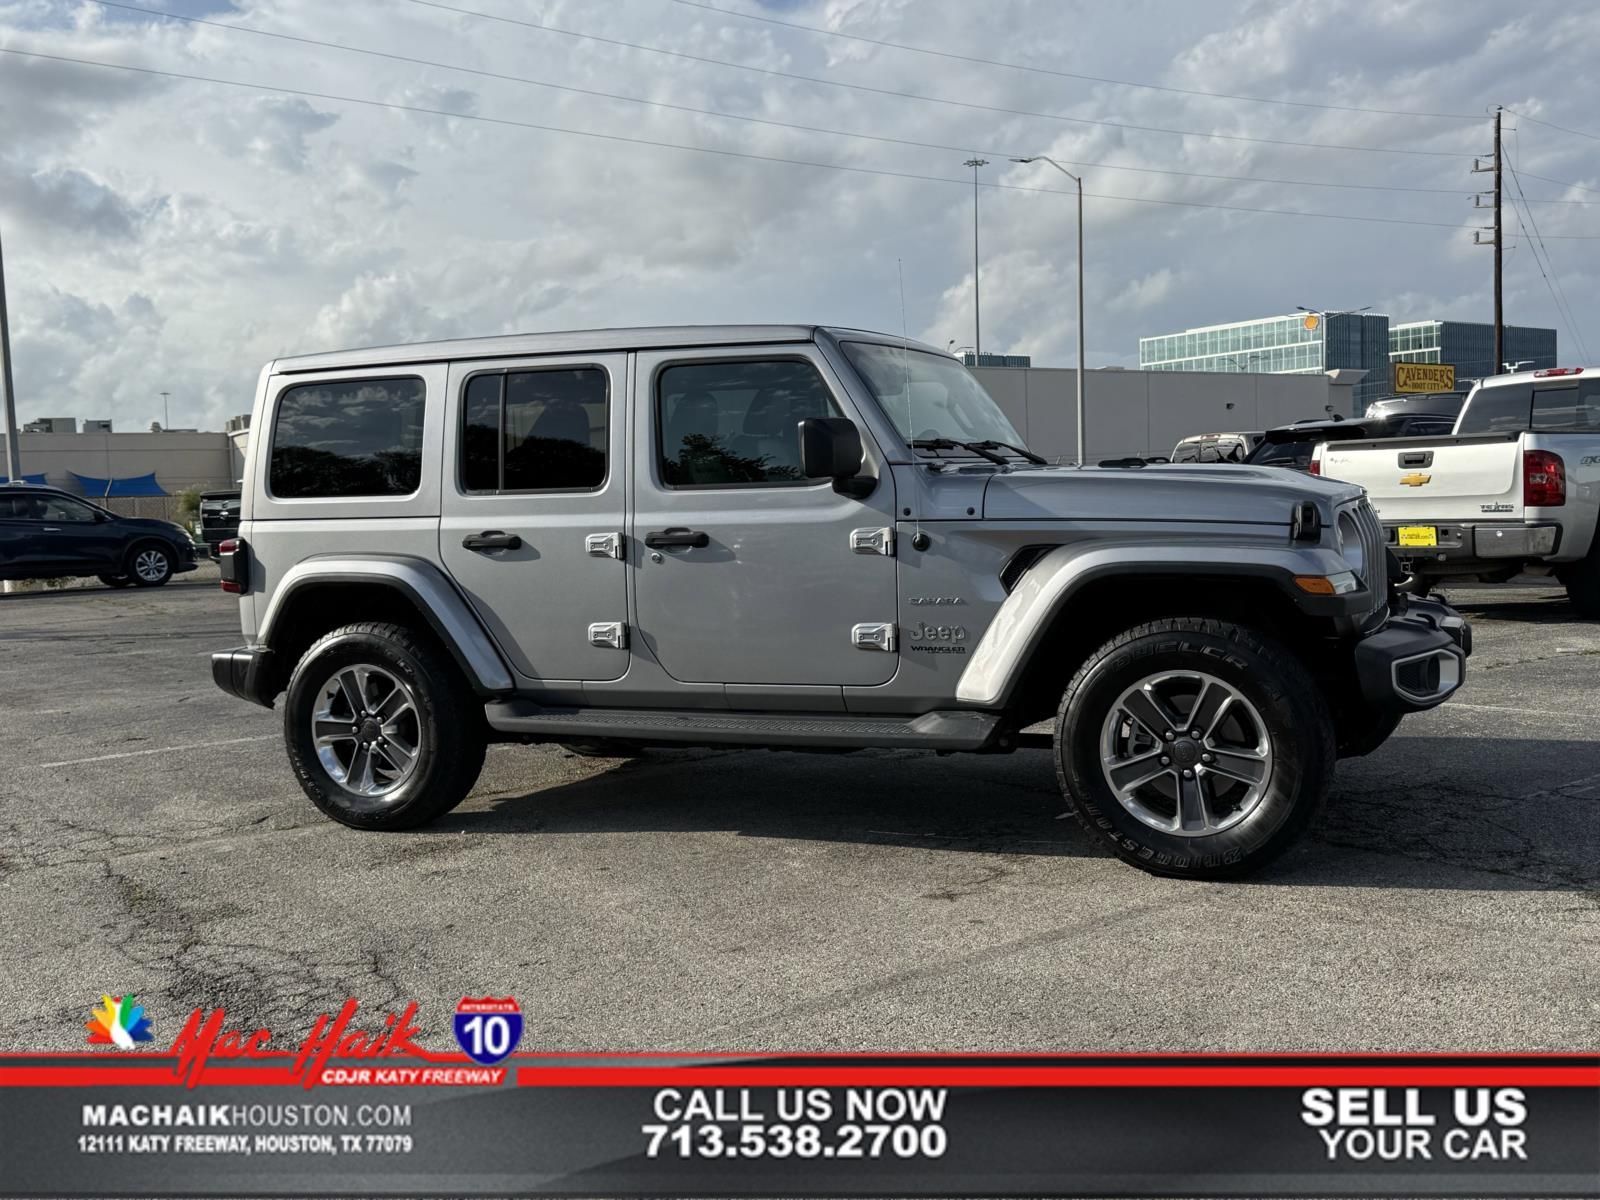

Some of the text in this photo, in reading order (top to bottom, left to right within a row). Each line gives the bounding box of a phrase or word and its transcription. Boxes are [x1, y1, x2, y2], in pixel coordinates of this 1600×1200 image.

[1396, 366, 1453, 390] CAVENDER'S
[1427, 382, 1441, 391] CITY
[1580, 455, 1600, 465] 4X
[909, 622, 966, 644] Jeep
